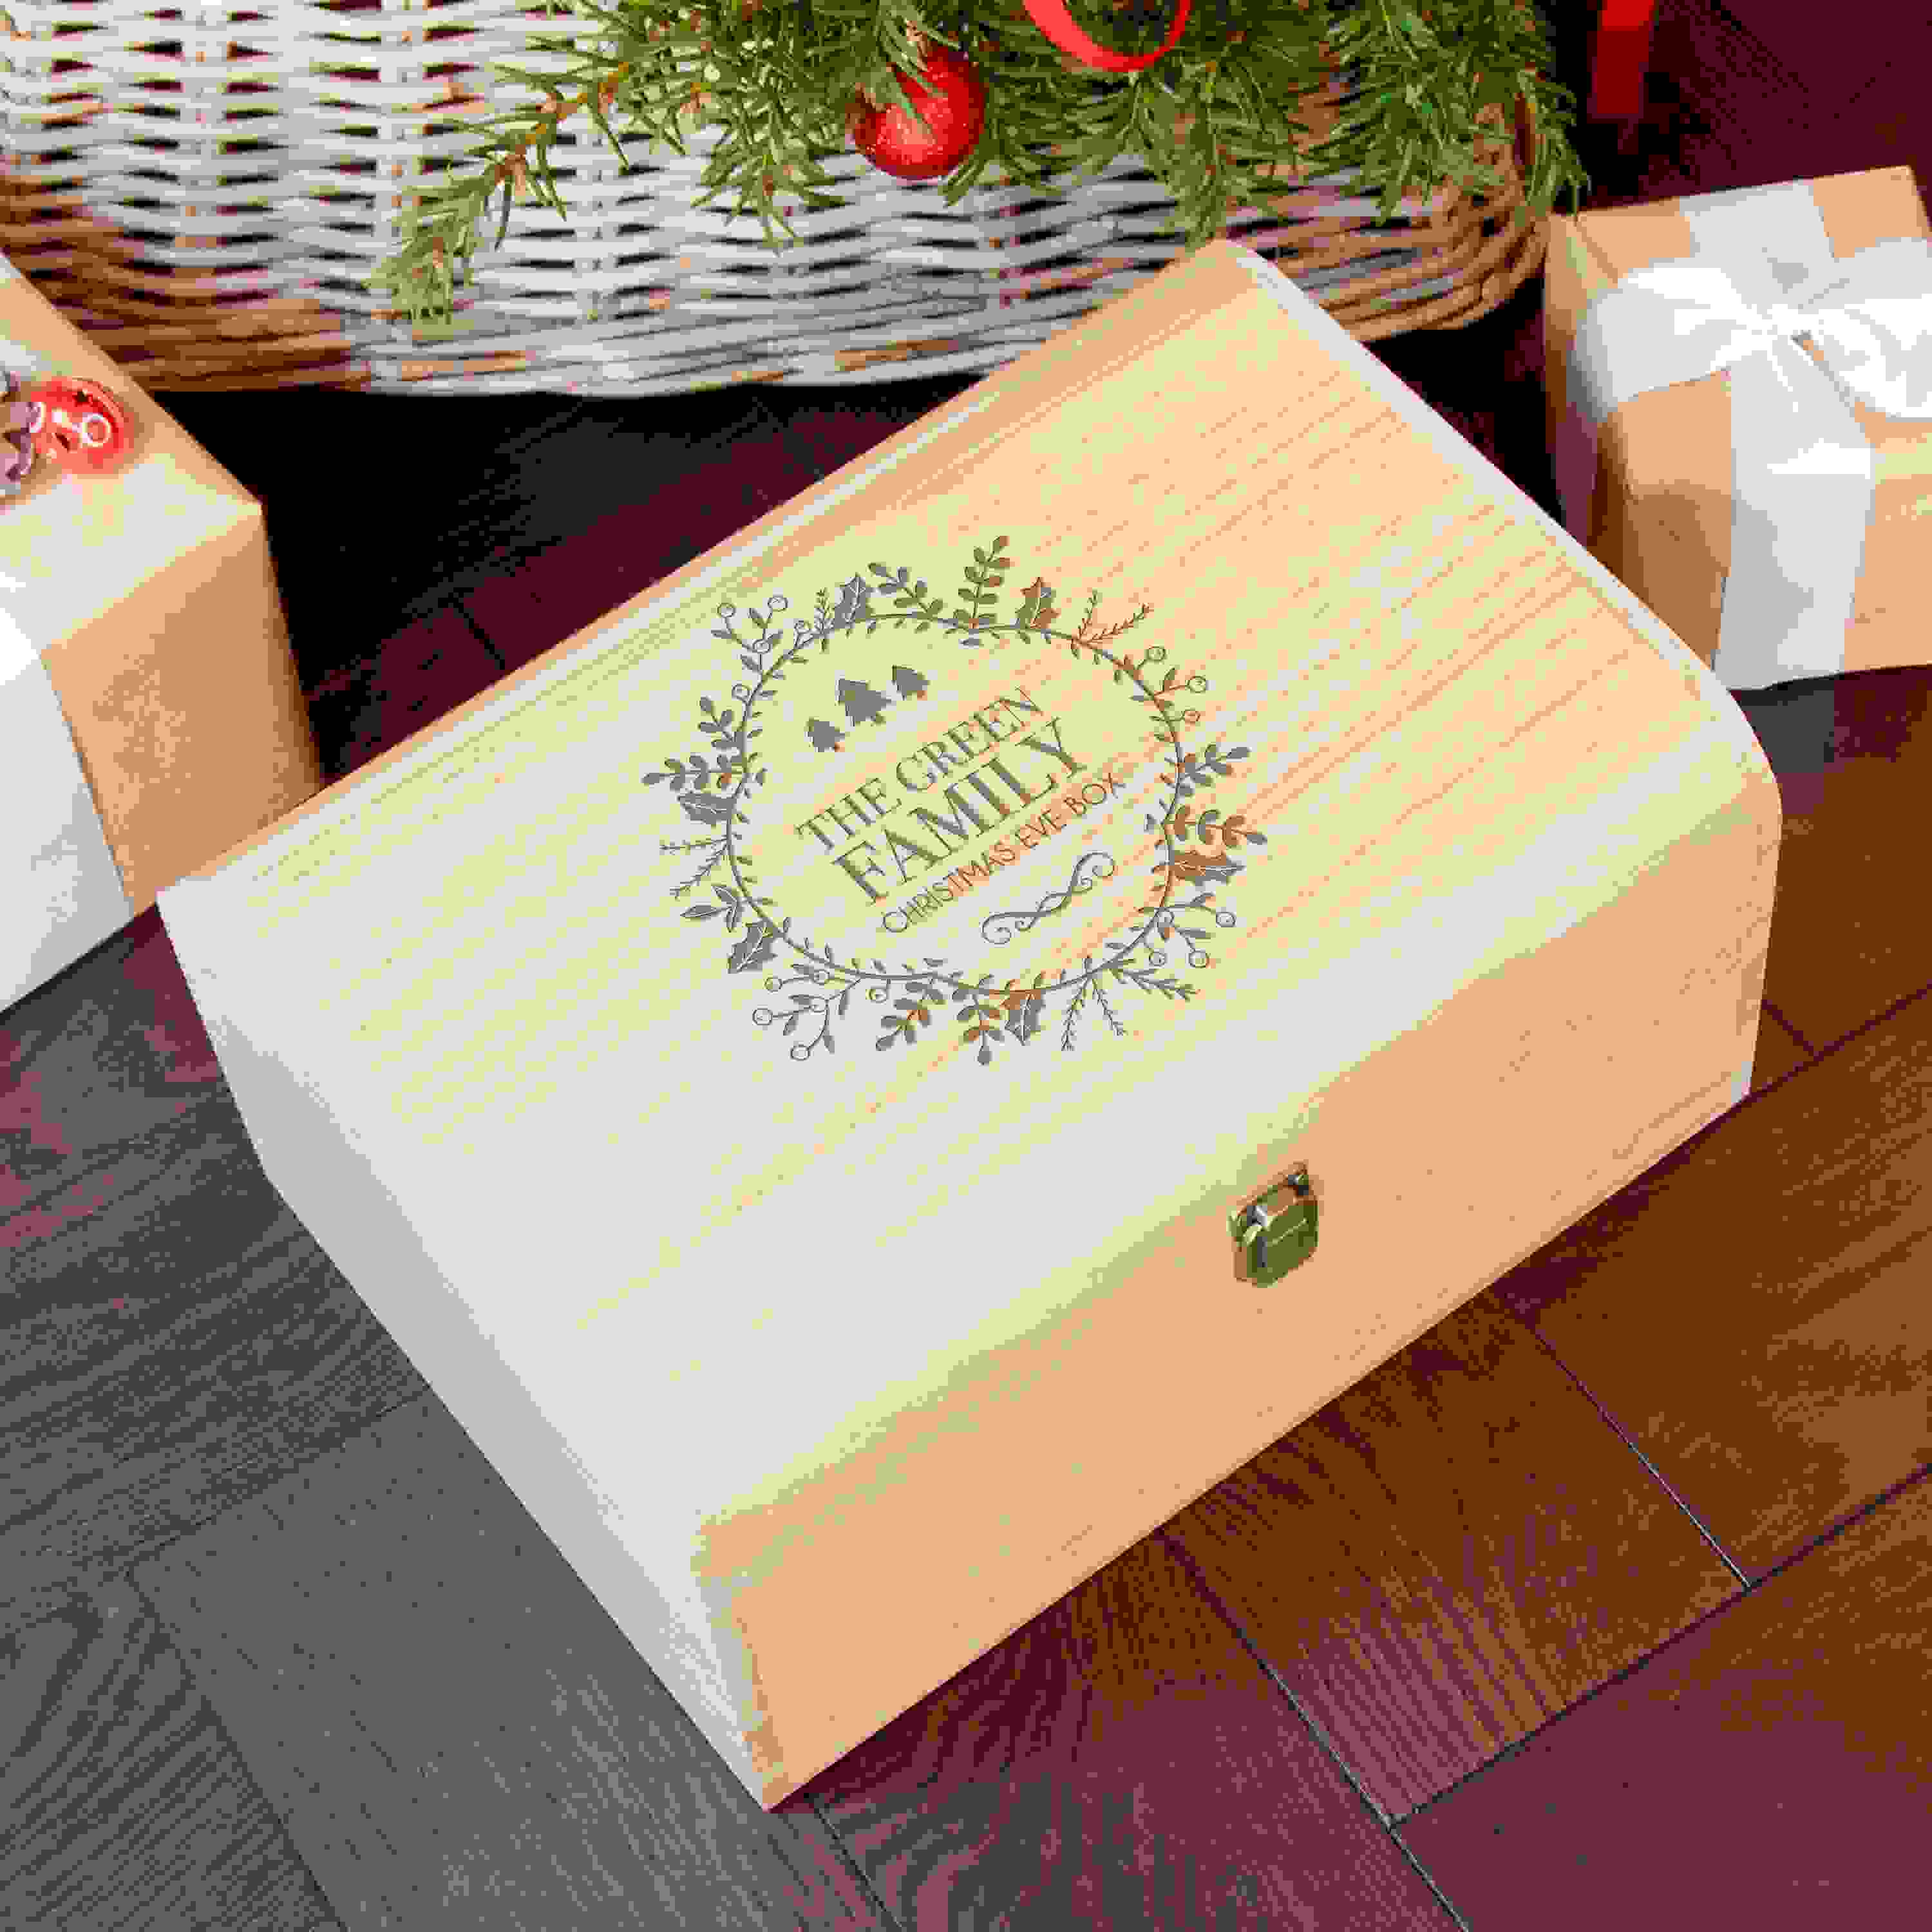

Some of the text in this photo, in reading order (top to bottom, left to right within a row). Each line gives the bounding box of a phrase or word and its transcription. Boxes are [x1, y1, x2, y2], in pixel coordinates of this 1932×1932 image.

[795, 687, 1043, 849] THE GREEN
[831, 717, 1087, 904] FAMILY
[882, 773, 1126, 933] CHRISTMAS EVE BOX
